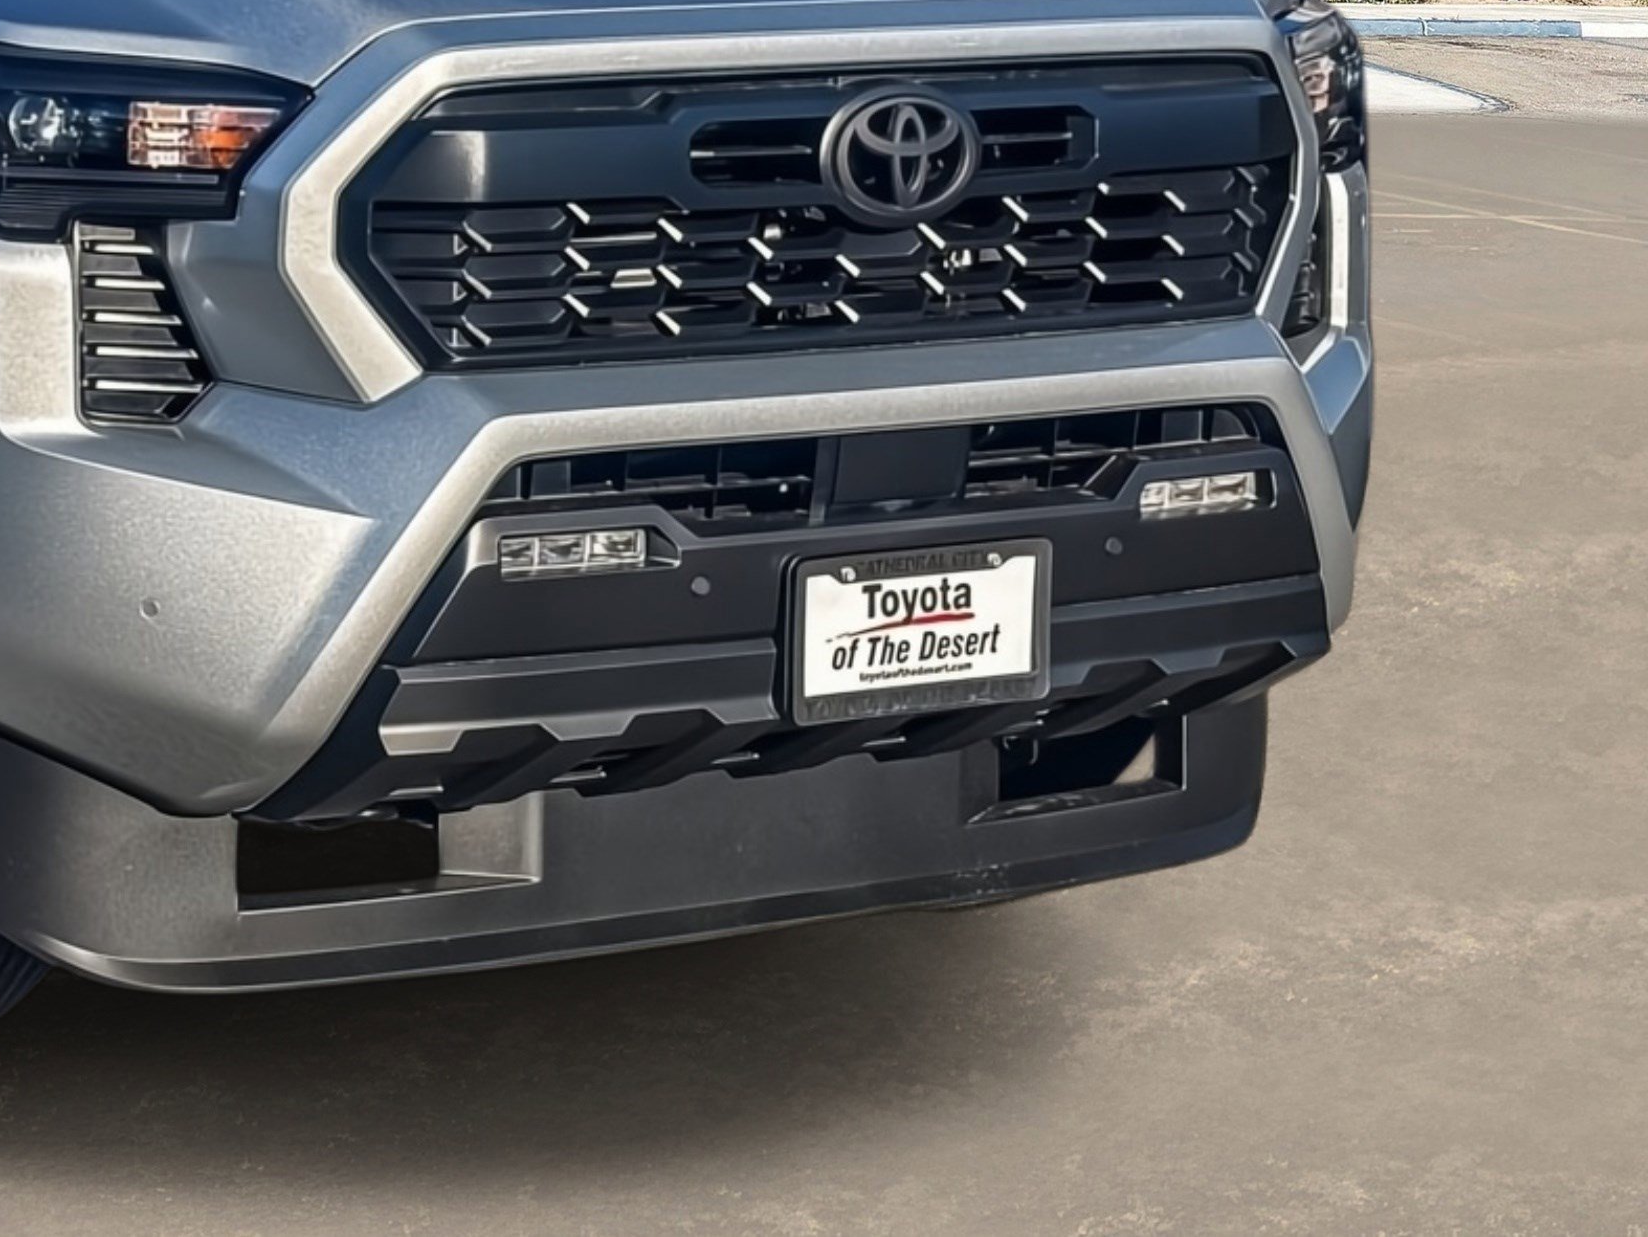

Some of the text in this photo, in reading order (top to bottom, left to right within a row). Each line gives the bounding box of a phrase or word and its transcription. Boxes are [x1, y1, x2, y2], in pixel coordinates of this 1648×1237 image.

[861, 578, 972, 624] Toyota
[831, 623, 1002, 670] of The Desert
